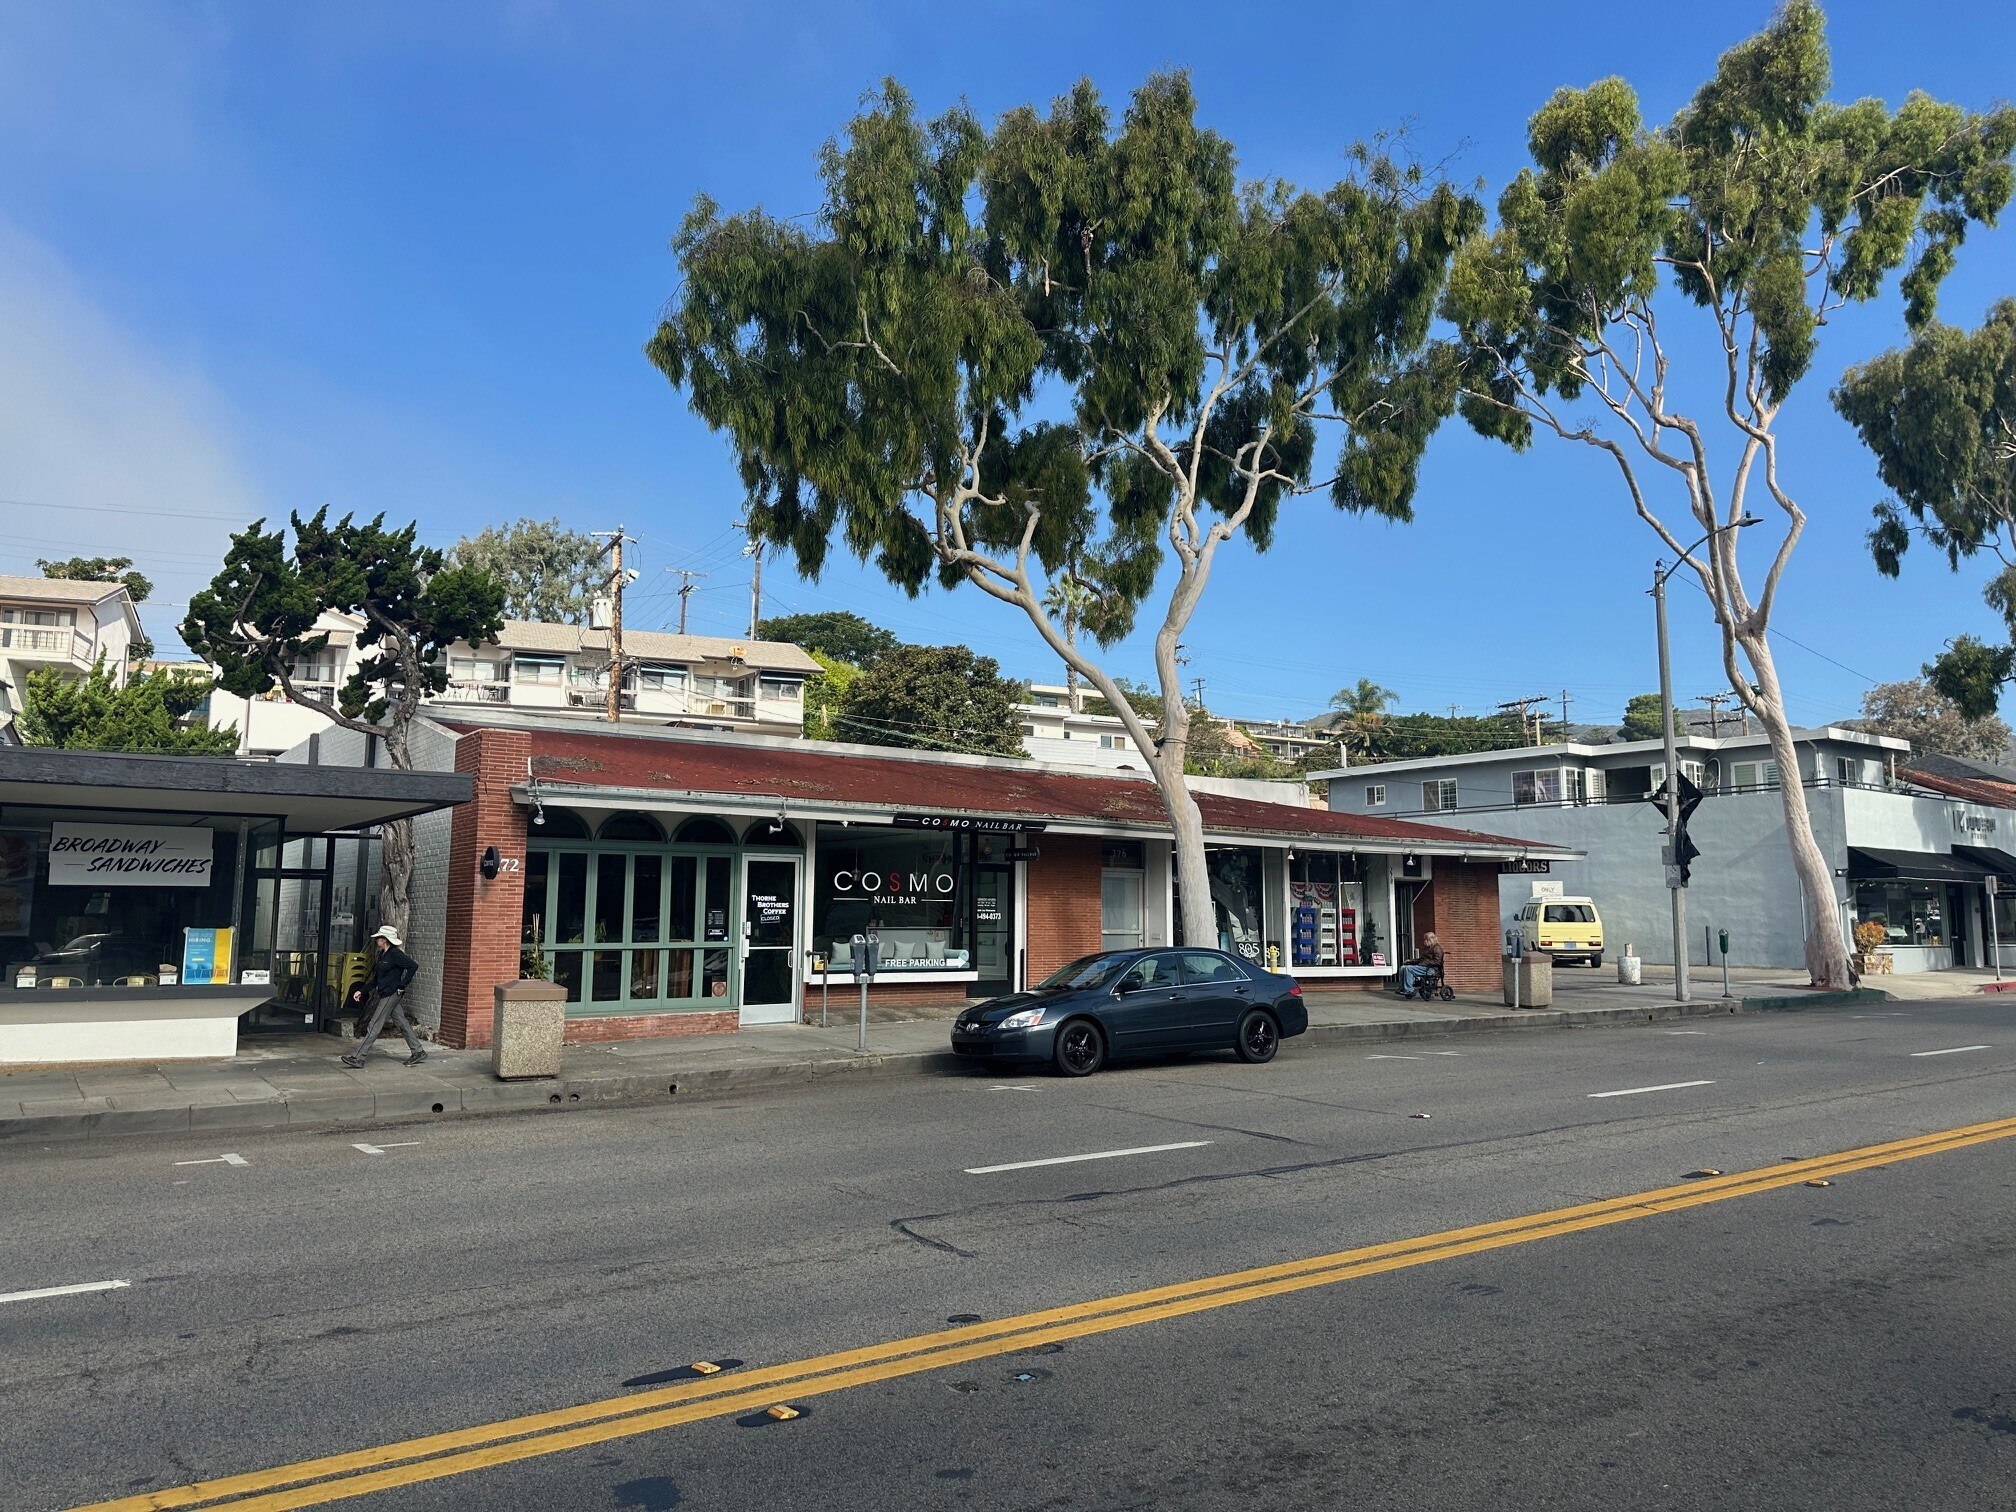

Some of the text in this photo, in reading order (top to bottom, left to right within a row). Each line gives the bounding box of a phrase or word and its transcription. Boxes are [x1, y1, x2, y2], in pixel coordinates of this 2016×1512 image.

[922, 818, 970, 828] COSMO
[974, 821, 1000, 829] NAIL
[52, 837, 166, 854] BROADWAY
[87, 856, 212, 874] SANDWICHES
[497, 858, 520, 872] 72
[834, 871, 953, 892] COSMO
[873, 895, 918, 904] NAIL BAR
[1238, 943, 1260, 956] 805
[885, 958, 946, 967] FREE PARKING
